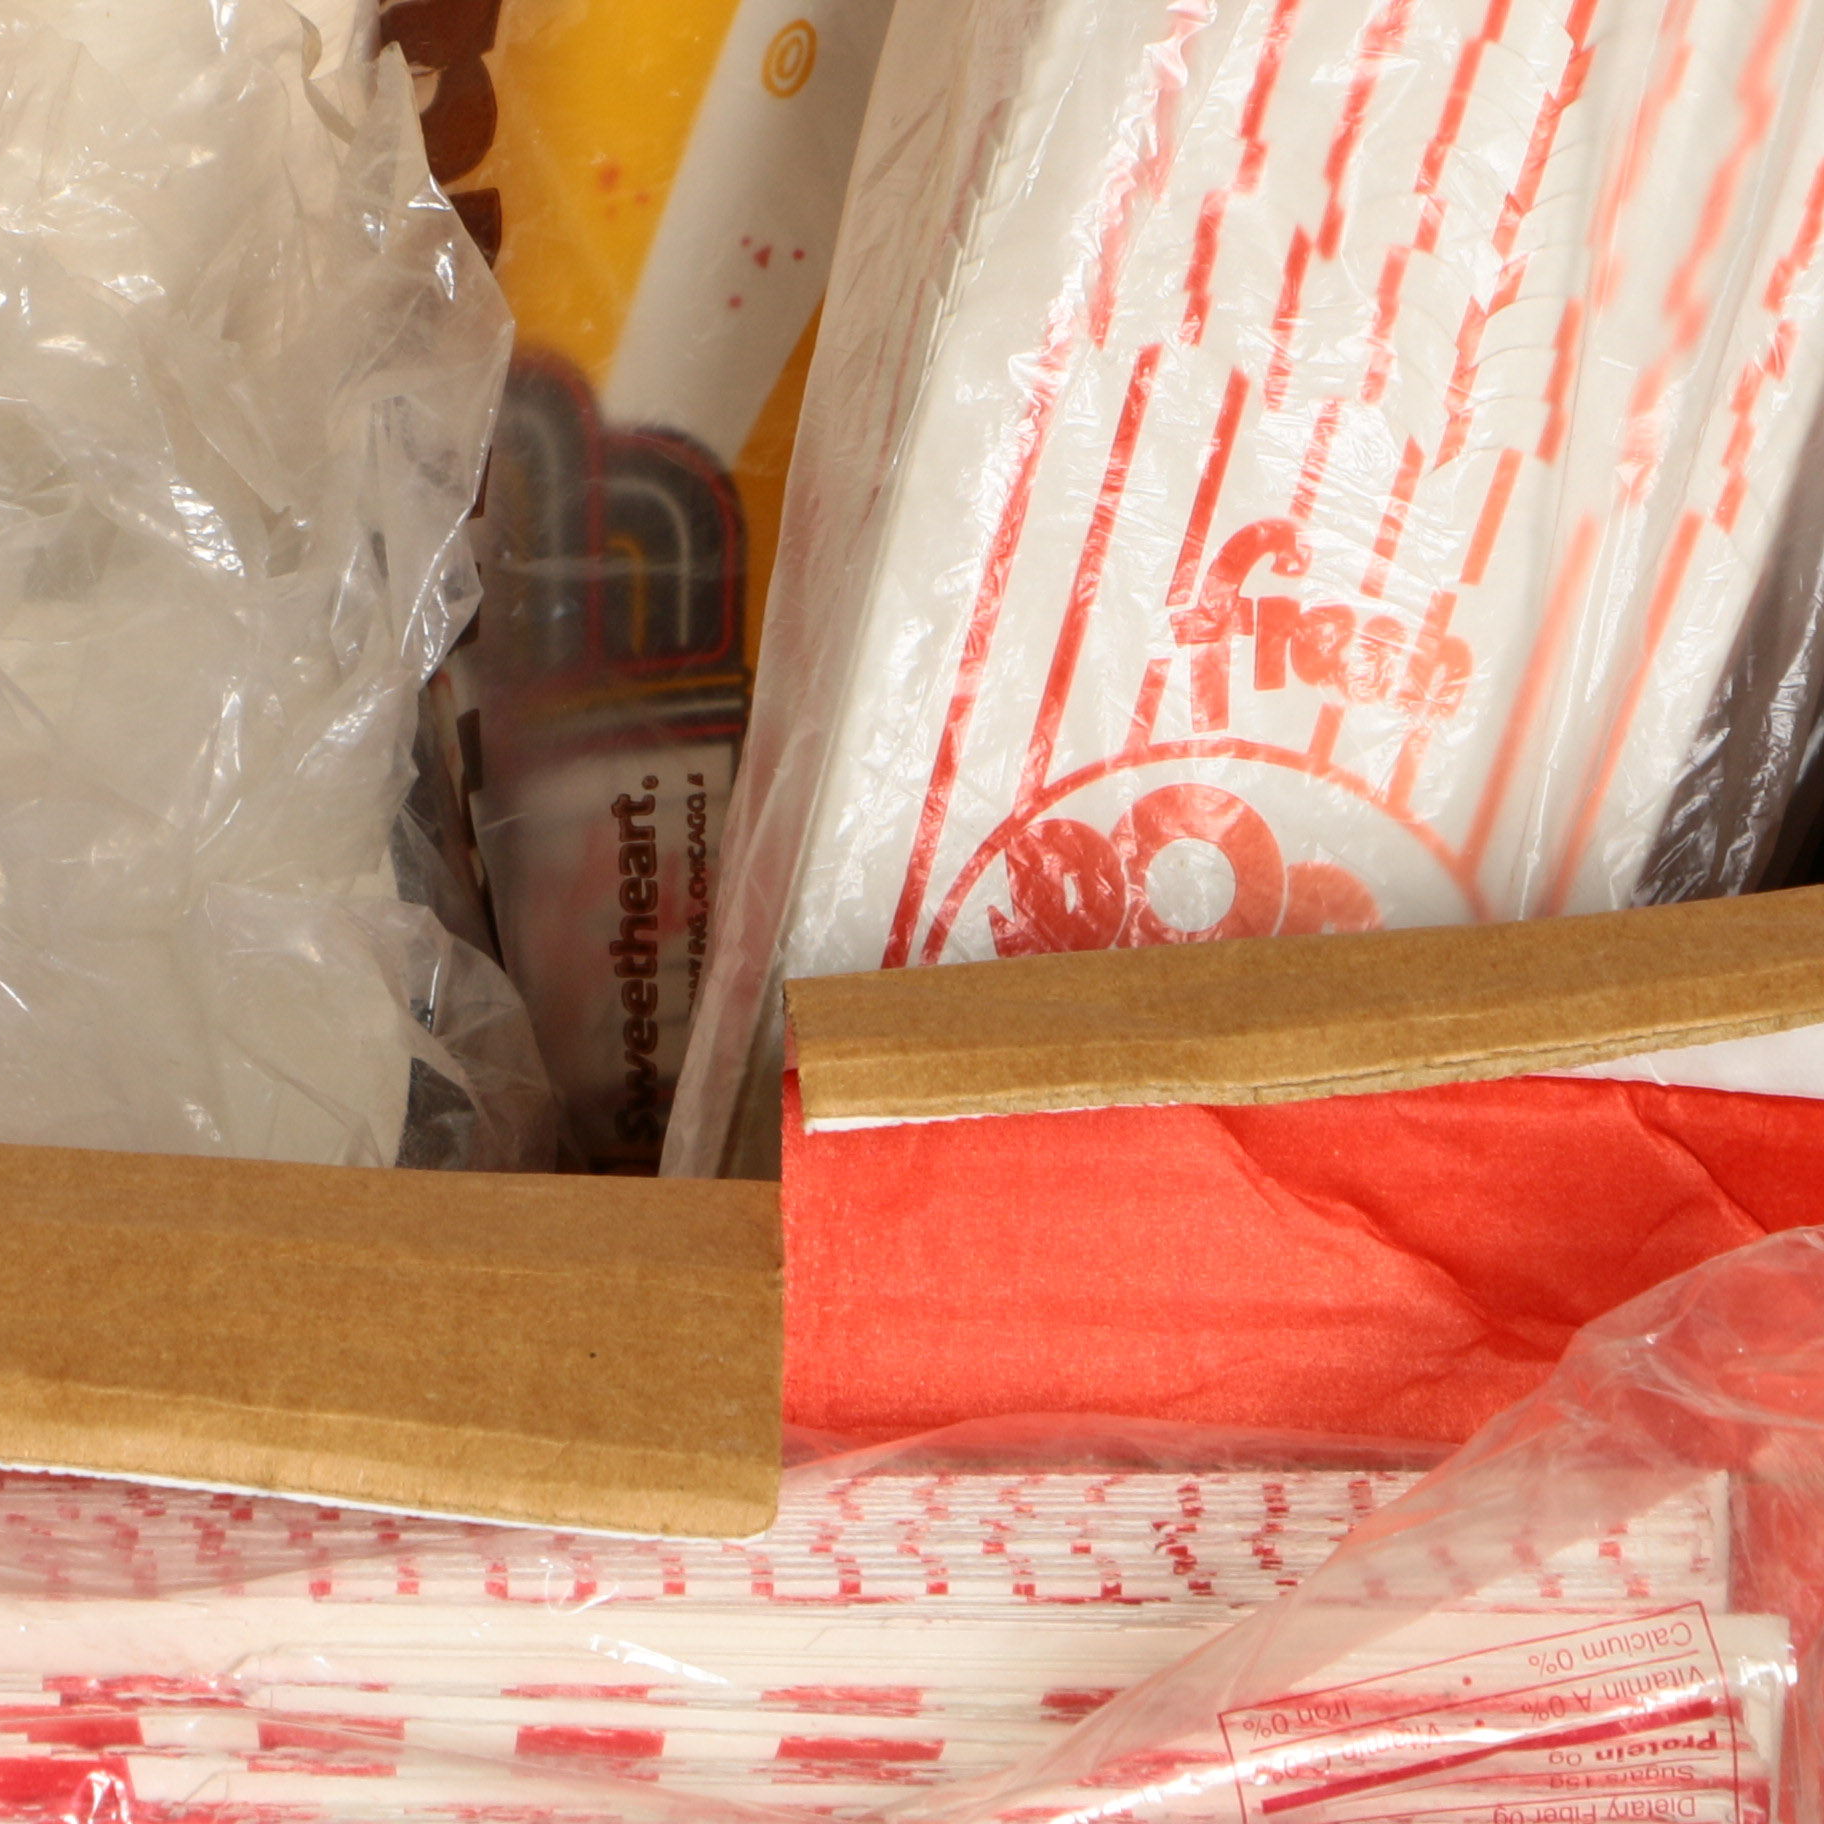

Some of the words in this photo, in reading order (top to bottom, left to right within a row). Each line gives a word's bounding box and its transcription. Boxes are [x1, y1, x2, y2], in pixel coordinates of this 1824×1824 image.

[1170, 516, 1473, 734] fresh
[1581, 1622, 1693, 1661] Calcium
[1528, 1648, 1574, 1676] 0%
[1572, 1688, 1593, 1706] A
[1602, 1665, 1705, 1702] Vitamin
[1296, 1699, 1352, 1724] Iron
[1521, 1695, 1567, 1722] 0%
[1242, 1713, 1289, 1740] 0%
[1548, 1750, 1582, 1767] 0g
[1595, 1730, 1717, 1761] Protein
[1606, 1764, 1695, 1784] Sugars
[1536, 1806, 1596, 1824] Fiber
[1606, 1797, 1696, 1819] Dietary
